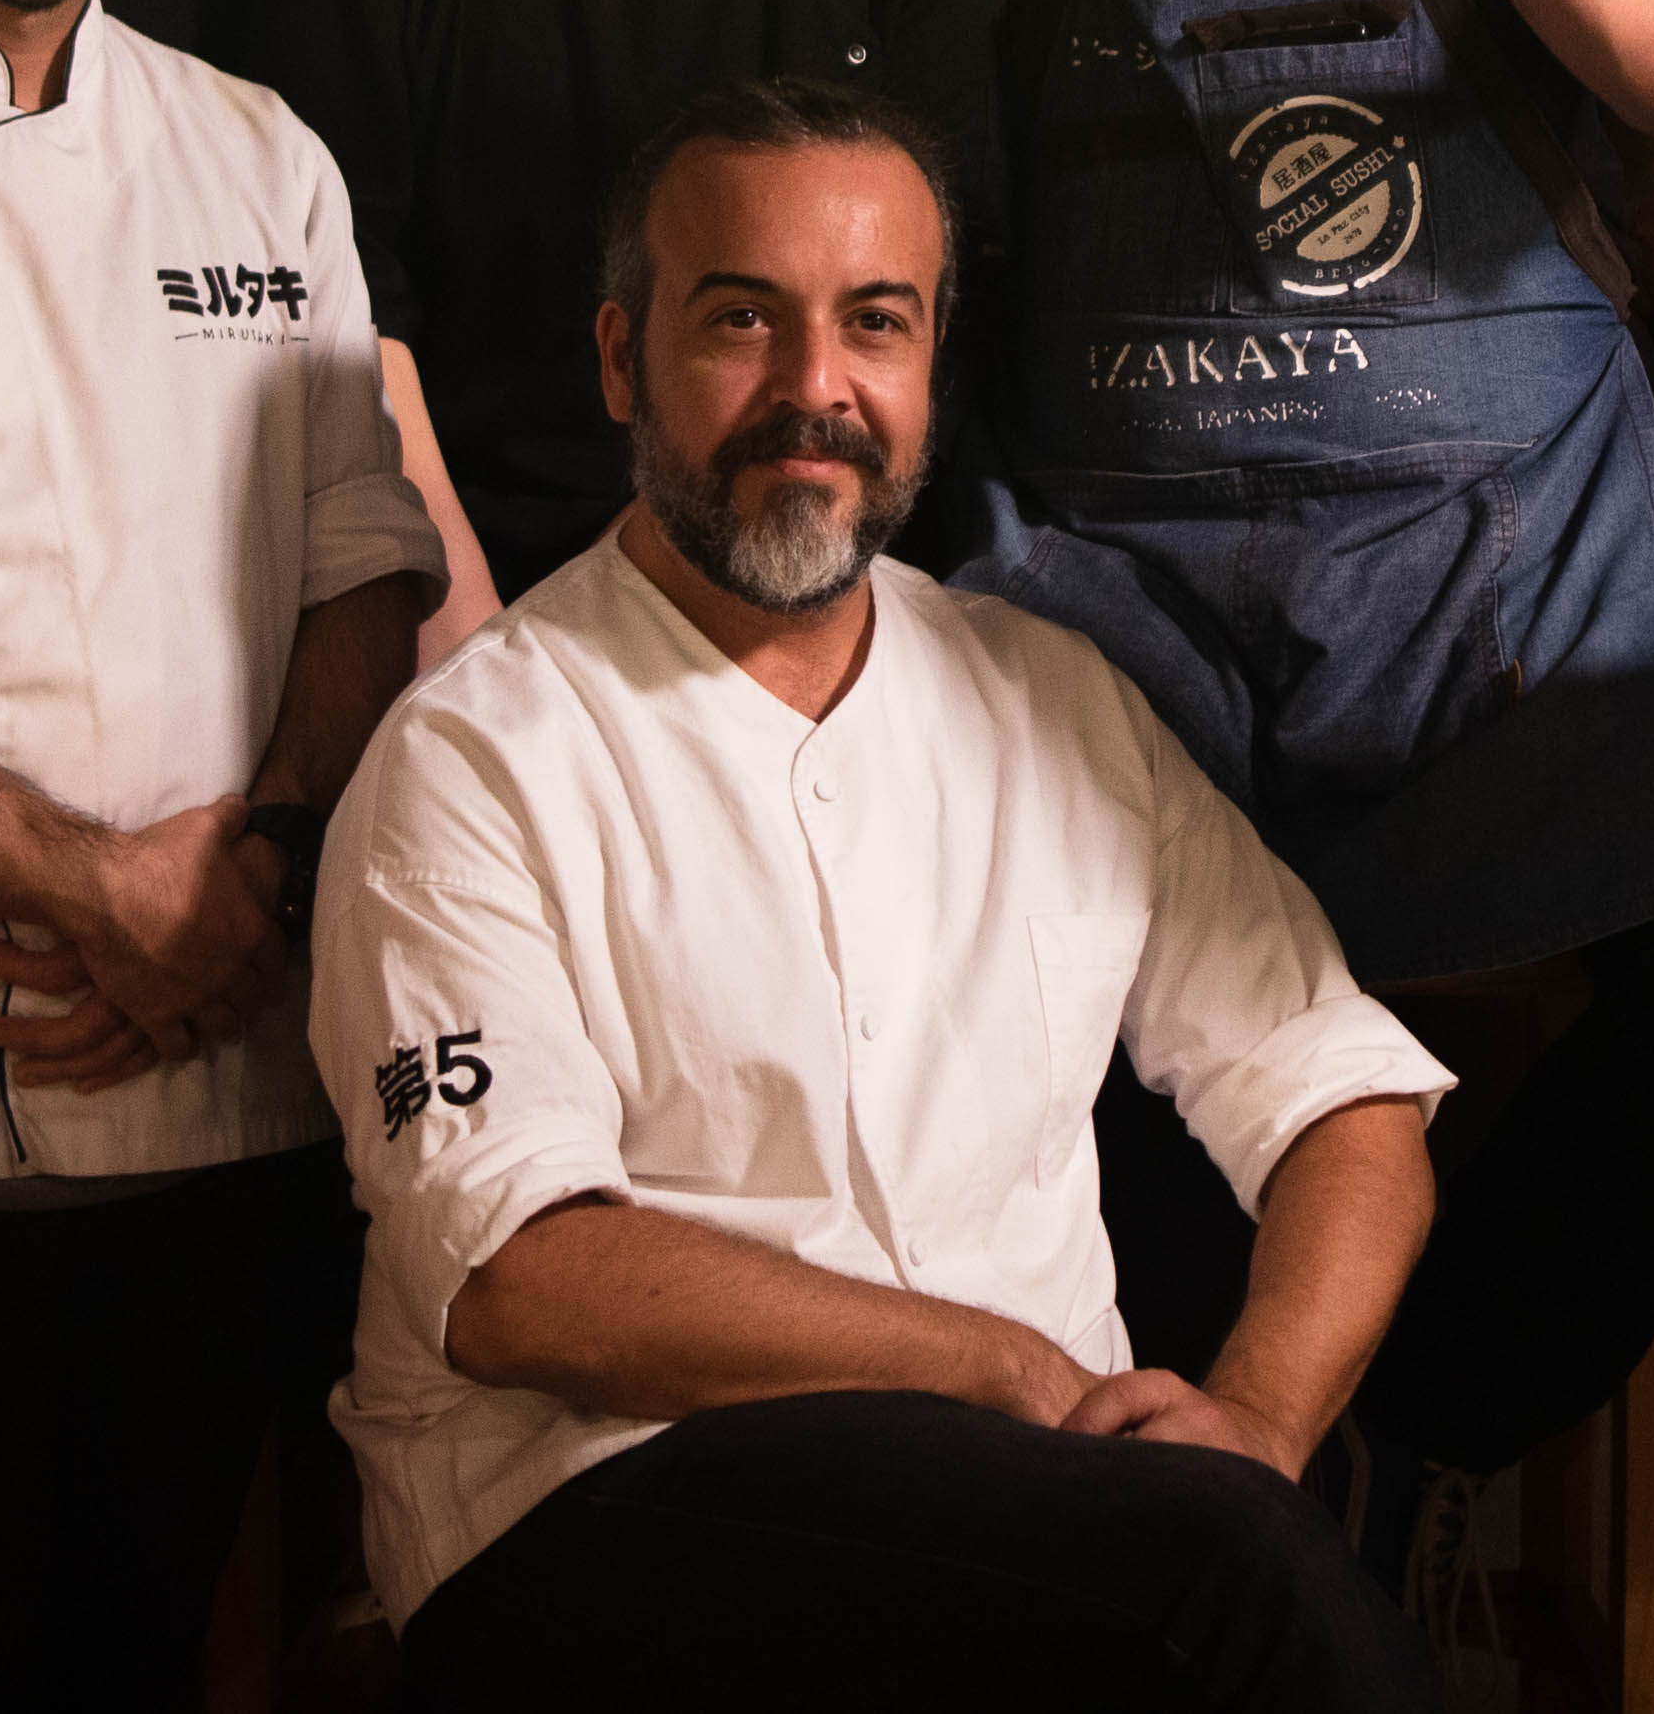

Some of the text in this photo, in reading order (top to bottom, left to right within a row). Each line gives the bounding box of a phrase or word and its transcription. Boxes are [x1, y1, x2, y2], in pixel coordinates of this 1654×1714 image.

[1272, 142, 1333, 192] 居酒屋
[1254, 147, 1396, 253] SOCIAL SUSHI
[156, 262, 309, 322] ミルタキ
